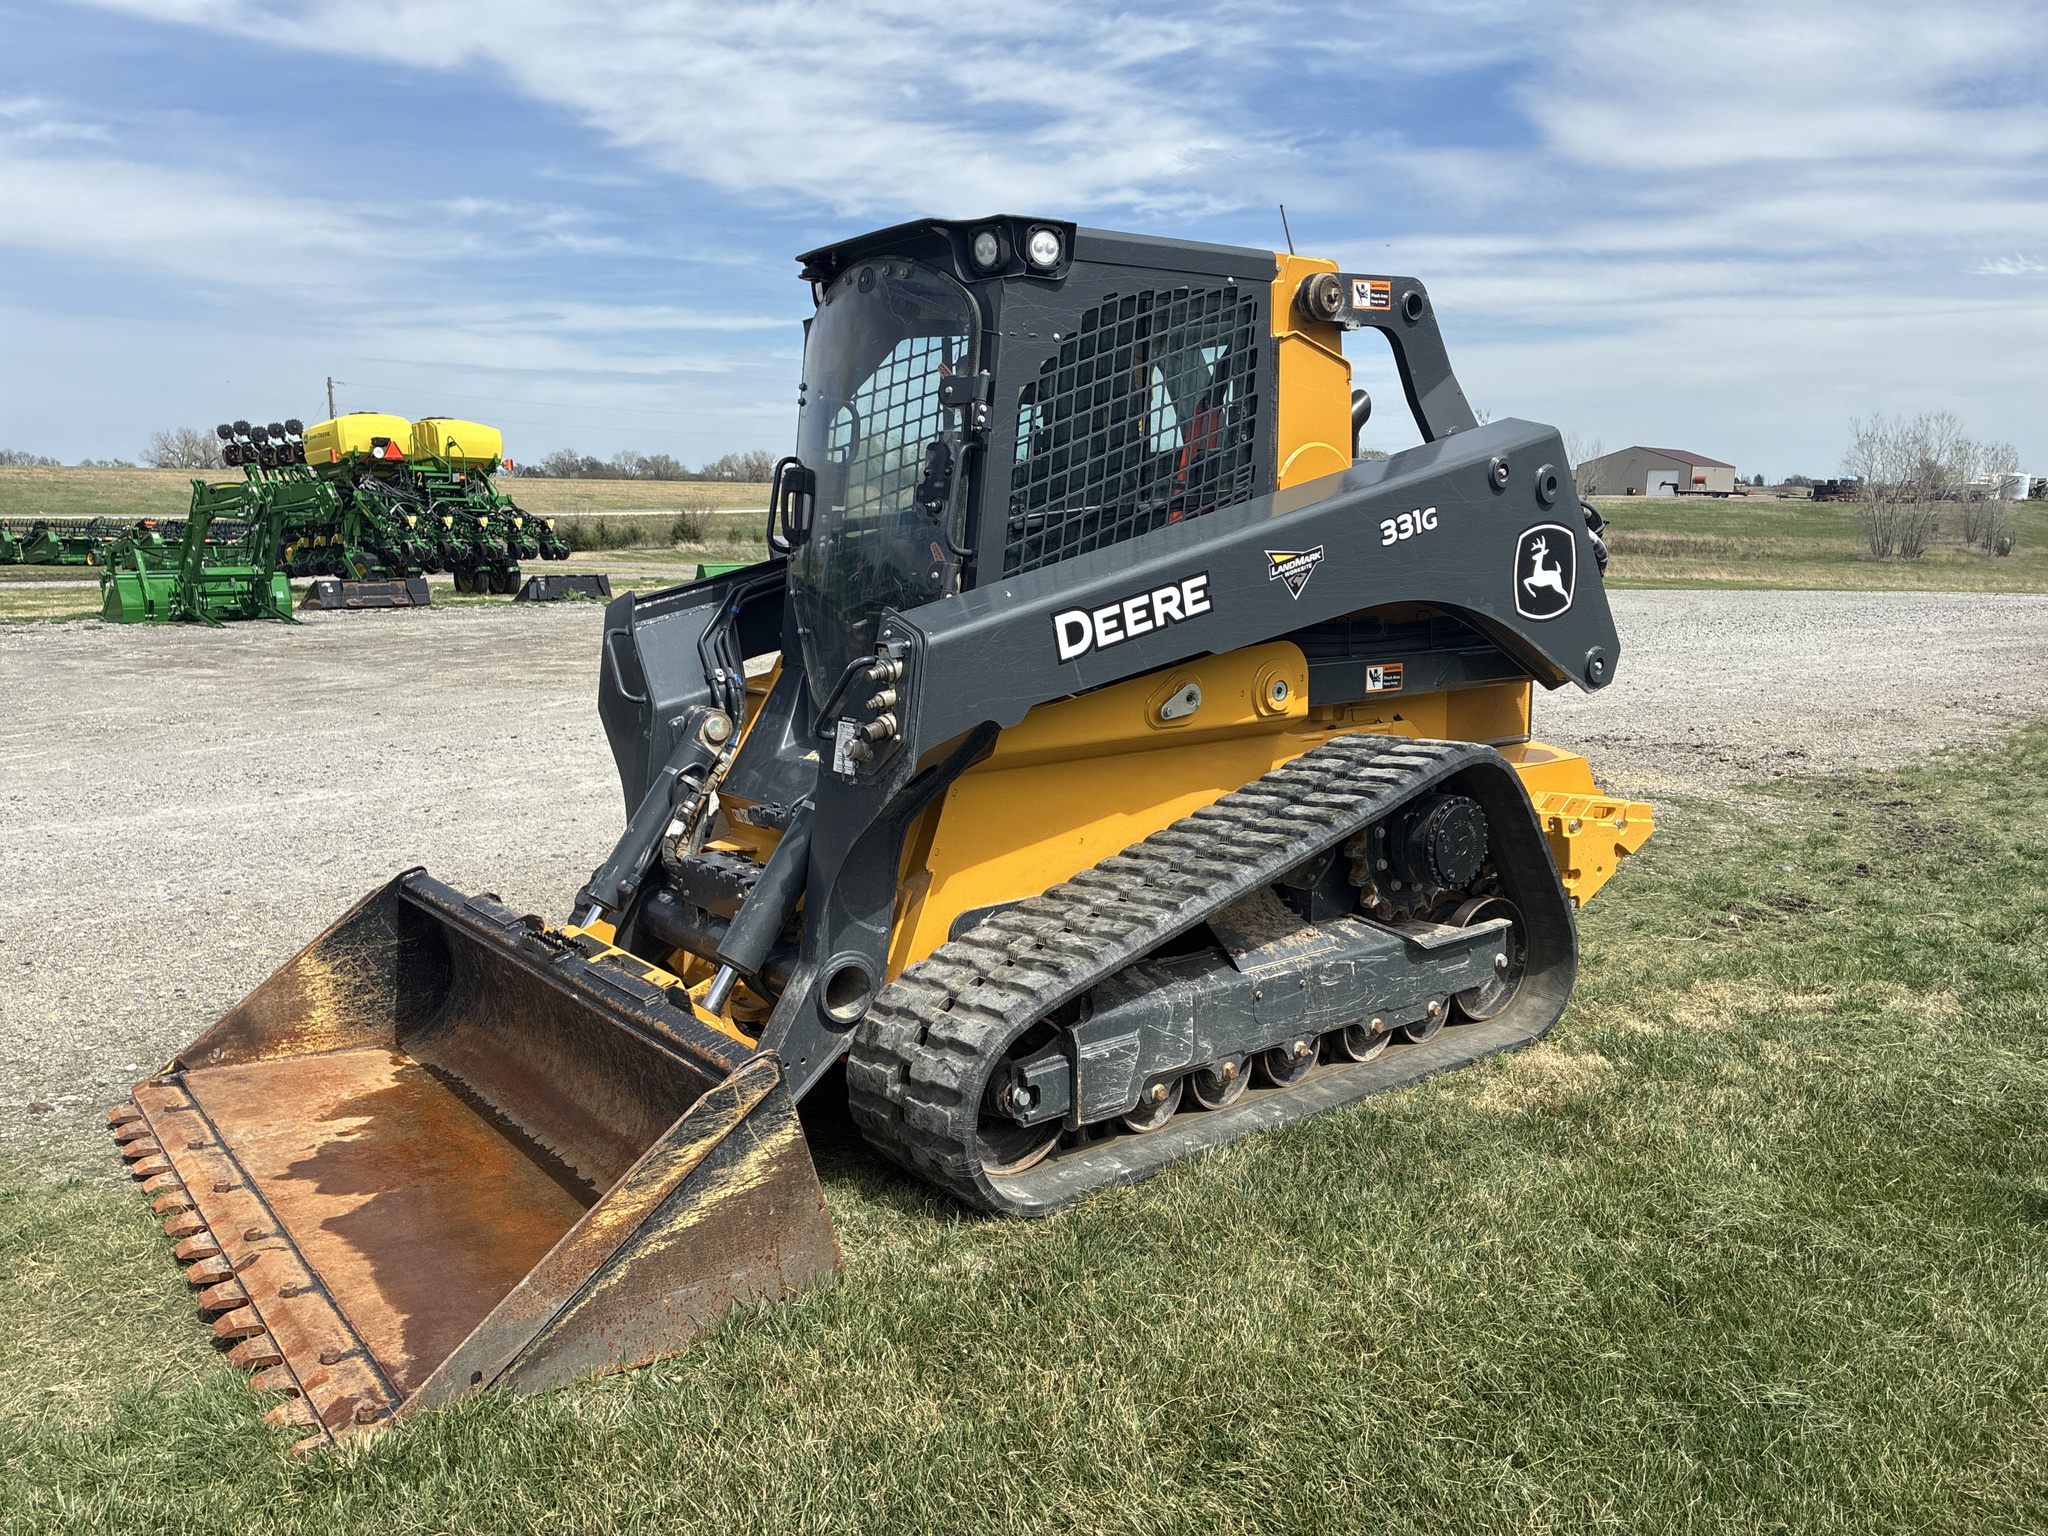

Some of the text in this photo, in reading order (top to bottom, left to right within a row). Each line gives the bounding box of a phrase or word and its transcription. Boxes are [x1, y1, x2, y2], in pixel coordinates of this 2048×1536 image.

[1379, 506, 1438, 546] 331G
[1271, 551, 1321, 576] LANDMARK
[1284, 562, 1312, 577] WORKSITE
[1053, 574, 1211, 661] DEERE
